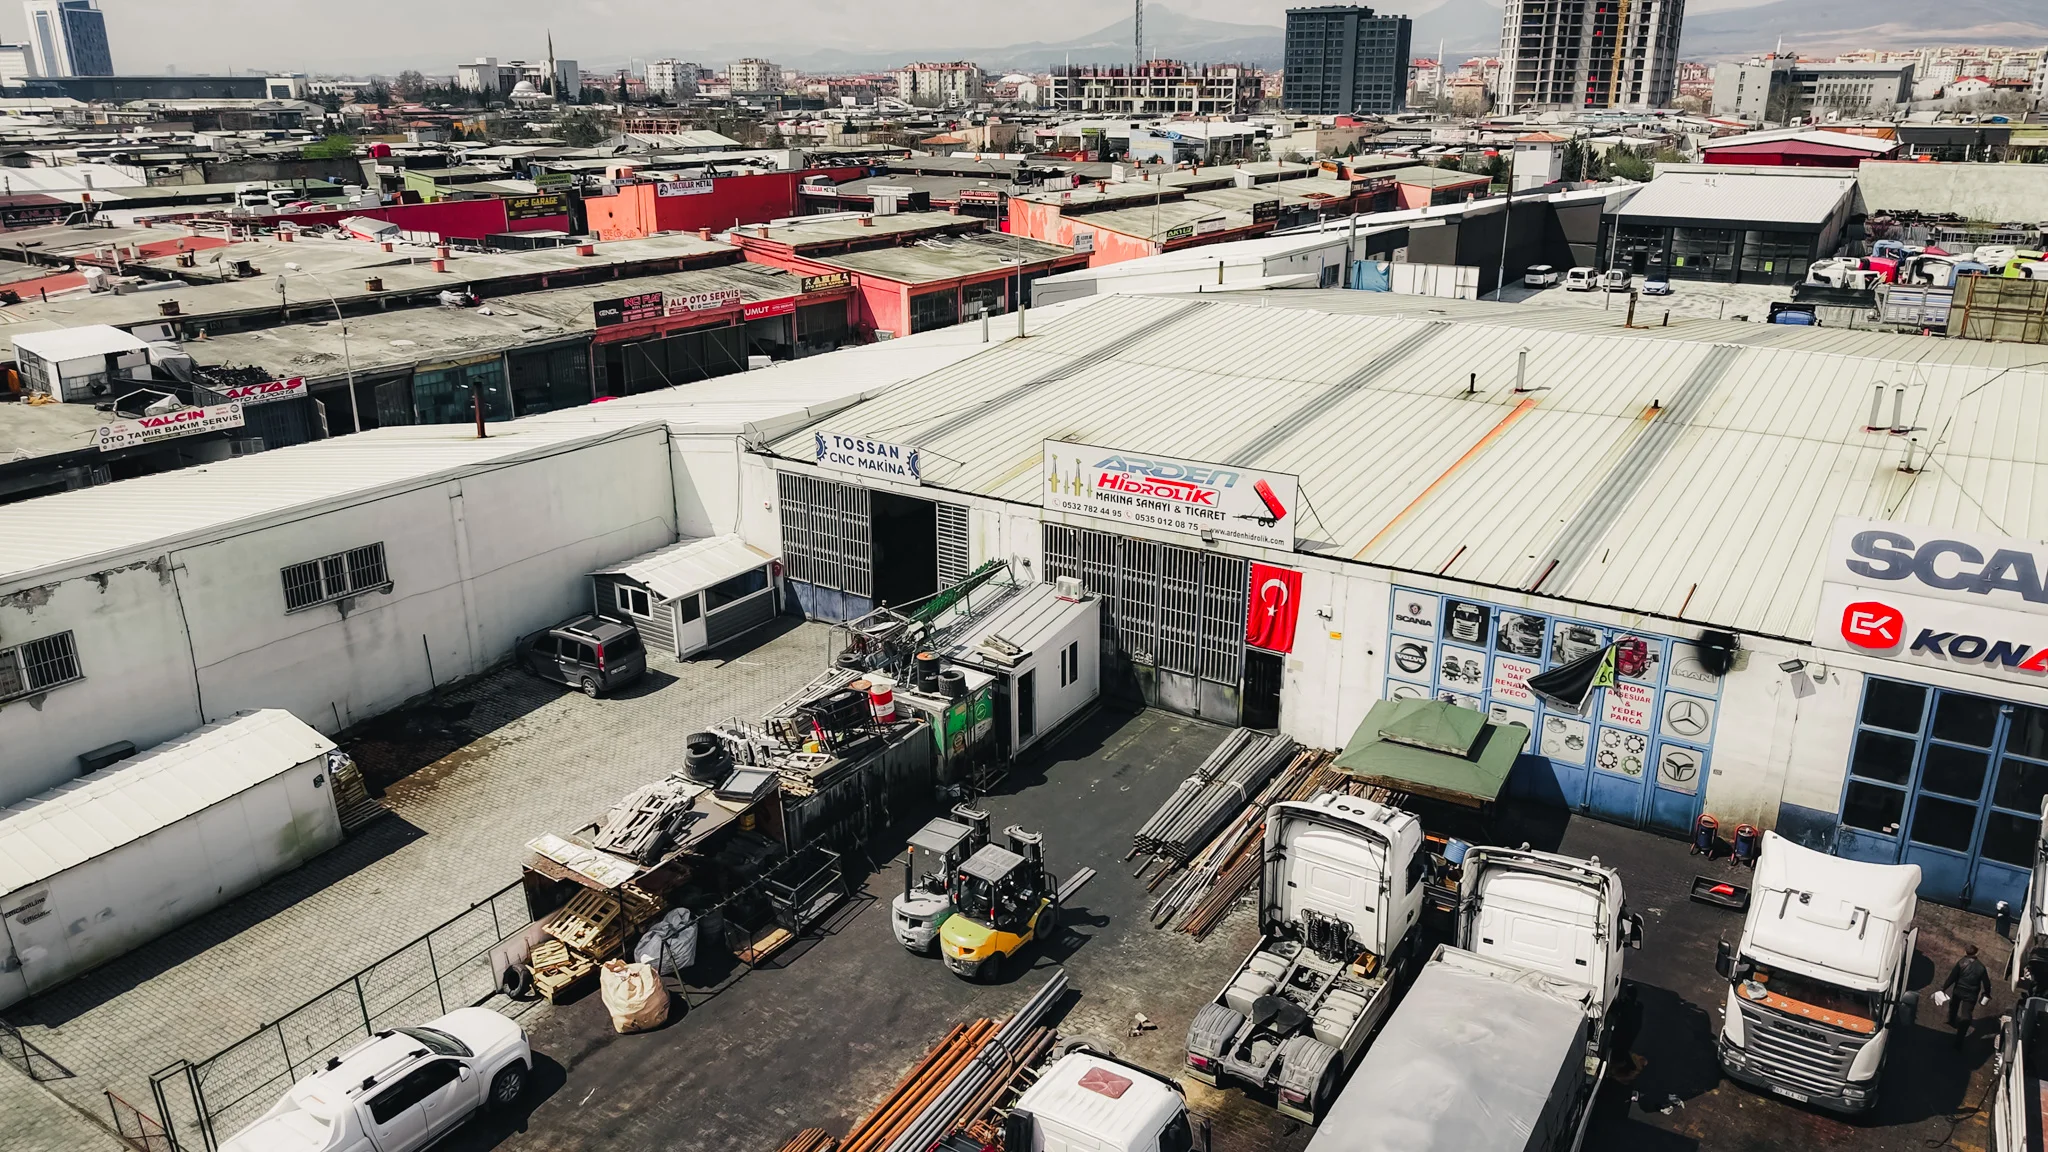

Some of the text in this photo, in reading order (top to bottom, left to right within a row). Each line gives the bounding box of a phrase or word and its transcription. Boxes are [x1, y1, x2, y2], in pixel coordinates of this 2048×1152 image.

[695, 179, 712, 188] METAL
[531, 196, 558, 206] GARAGE
[670, 289, 739, 307] ALP OTO SERVIS
[745, 306, 769, 316] UMUT
[253, 389, 295, 400] KAPORTA
[101, 435, 124, 444] OTO
[165, 421, 199, 433] BAKIM
[833, 436, 900, 459] TOSSAN
[830, 452, 905, 476] CNC MAKİNA
[1096, 491, 1133, 505] MAKINA
[1136, 498, 1170, 512] SANAYI
[1174, 505, 1181, 514] &
[1062, 501, 1199, 531] 0532 782 44 95 0535 012 08 75
[1846, 530, 2048, 605] SCA
[1395, 614, 1432, 627] SCANIA
[1396, 653, 1425, 664] VOLVO
[1502, 663, 1531, 674] VOLVO
[1507, 672, 1524, 681] DAF
[1676, 669, 1714, 683] MAN
[1500, 688, 1527, 699] IVECO
[1616, 683, 1644, 694] KROM
[1608, 689, 1651, 703] AKSESUAR
[1611, 705, 1643, 717] YEDEK
[1610, 713, 1641, 725] PARÇA
[1773, 1020, 1828, 1043] SCANIA
